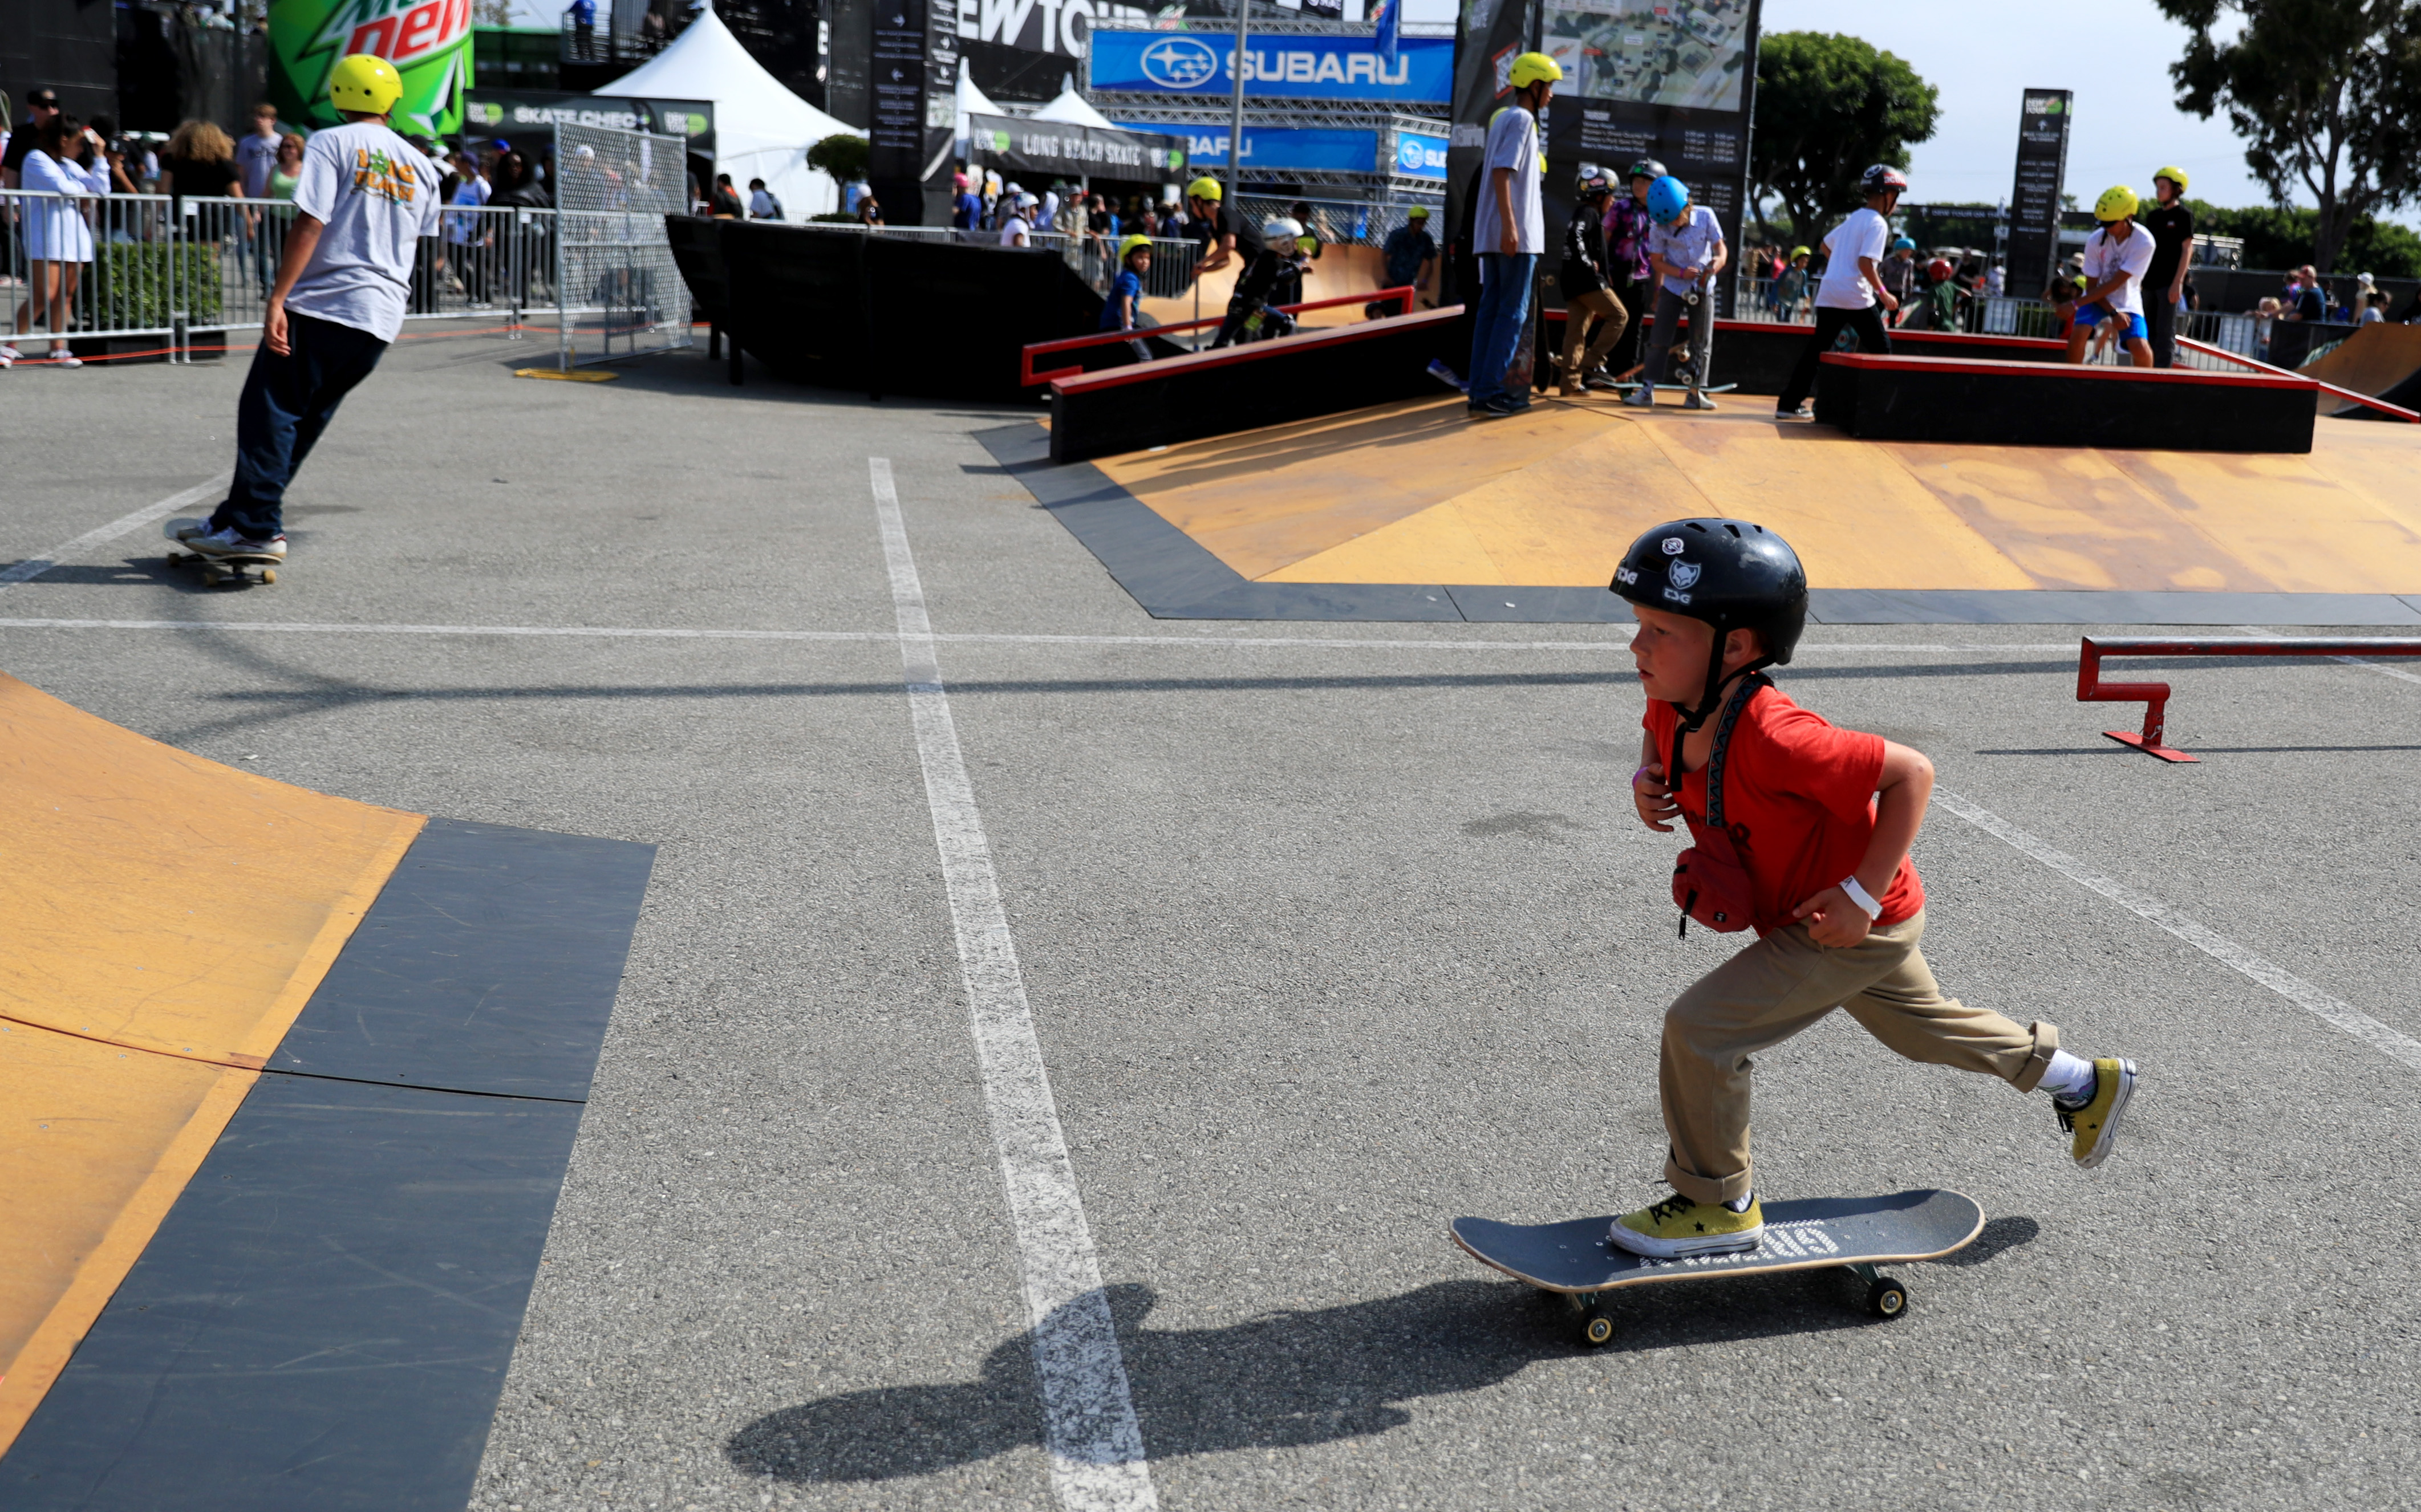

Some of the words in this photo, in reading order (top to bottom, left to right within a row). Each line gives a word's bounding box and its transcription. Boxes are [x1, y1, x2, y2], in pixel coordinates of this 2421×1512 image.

[1226, 50, 1409, 85] SUBARU
[1023, 134, 1059, 157] LONG
[1064, 140, 1104, 162] BEACH
[1105, 143, 1141, 166] SKATE
[1617, 567, 1638, 585] TSG
[1664, 587, 1691, 604] TSG
